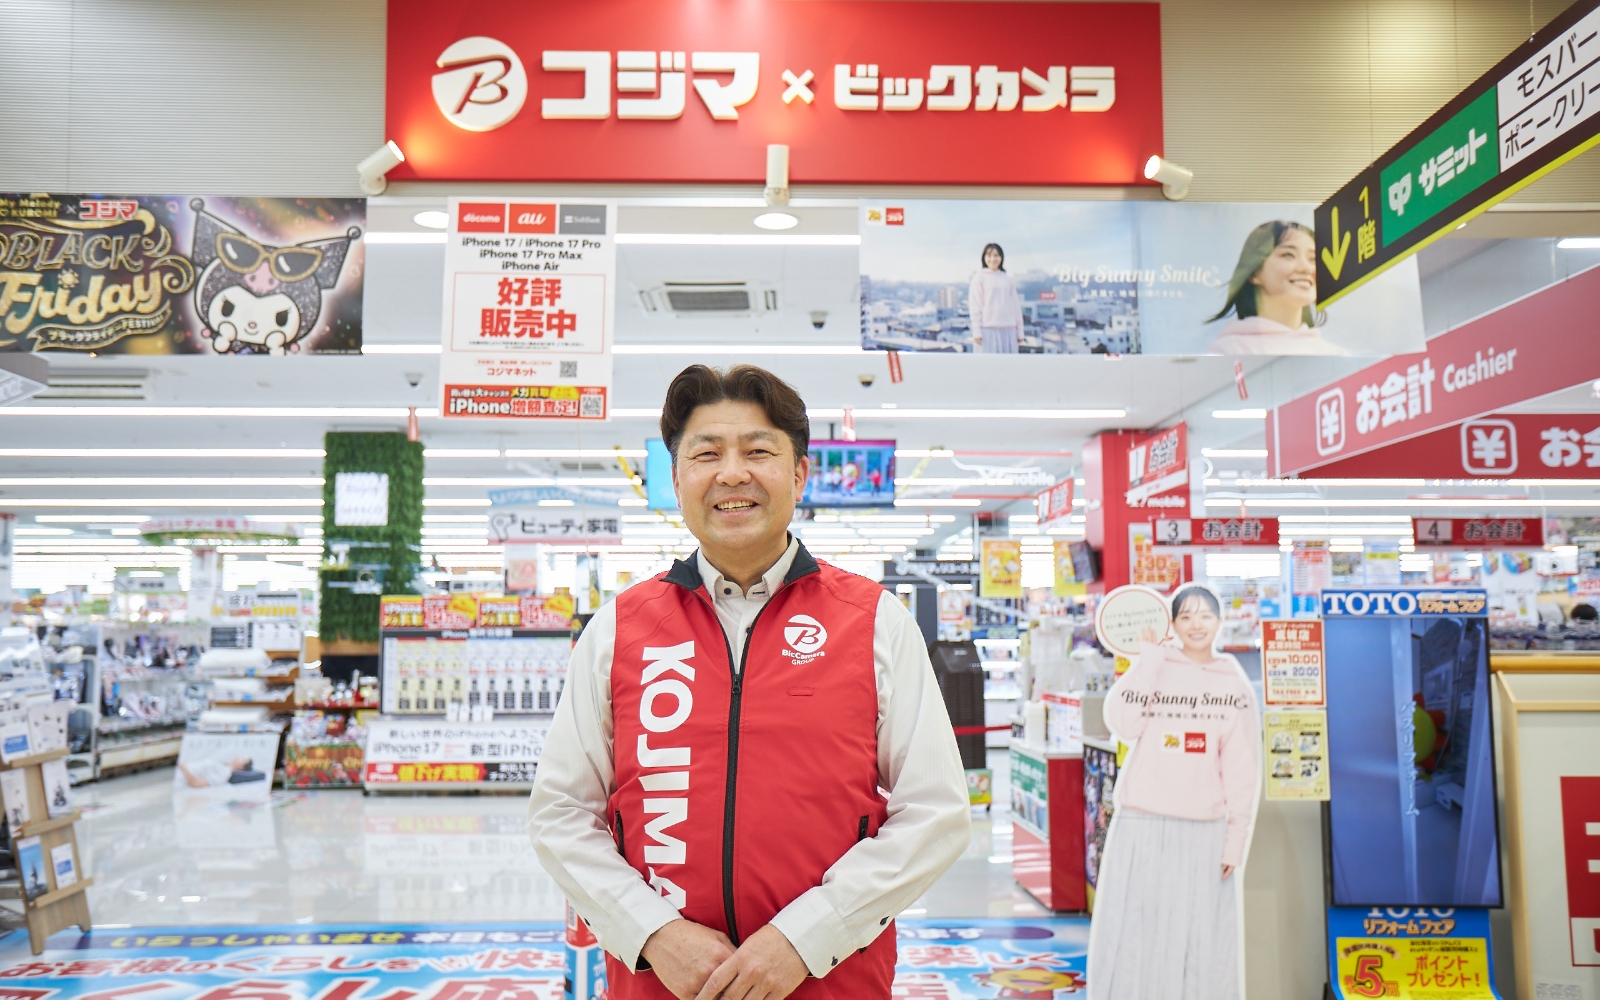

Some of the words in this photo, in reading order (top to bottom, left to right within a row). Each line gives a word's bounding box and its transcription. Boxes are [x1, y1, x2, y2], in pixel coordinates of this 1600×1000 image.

[541, 50, 760, 121] コジマ
[833, 63, 1116, 113] ビックカメラ
[1418, 128, 1488, 197] サミット
[79, 199, 139, 220] コジマ
[463, 212, 500, 223] docomo
[517, 212, 547, 225] au
[3, 231, 145, 273] BLACK
[462, 237, 501, 247] iPhone
[505, 238, 516, 247] 17
[525, 238, 564, 248] iPhone
[568, 239, 579, 248] 17
[582, 240, 601, 249] Pro
[479, 248, 518, 259] iPhone
[522, 250, 533, 259] 17
[536, 250, 555, 260] Pro
[558, 250, 582, 260] Max
[502, 260, 540, 271] iPhone
[544, 261, 560, 271] Air
[1054, 264, 1091, 288] Big
[1094, 264, 1155, 288] Sunny
[1159, 264, 1222, 288] Smile
[497, 276, 562, 307] 好評
[0, 269, 162, 334] Friday
[480, 307, 577, 339] 販売中
[487, 366, 537, 377] コジマネット
[1356, 357, 1436, 435] お会計
[1443, 346, 1518, 393] Cashier
[521, 518, 619, 534] ビューティ家電
[1167, 522, 1179, 541] 3
[1202, 518, 1264, 541] お会計
[1427, 521, 1440, 541] 4
[1464, 519, 1526, 541] お会計
[1322, 590, 1417, 616] TOTO
[781, 649, 825, 660] BicCamera
[791, 657, 815, 665] GROUP
[1288, 654, 1319, 665] 10:00
[1121, 689, 1149, 708] Big
[1151, 690, 1198, 709] Sunny
[1200, 692, 1248, 710] Smile
[1363, 918, 1456, 936] リフォームフェア
[110, 931, 405, 948] いらっしゃいませ
[1415, 953, 1469, 971] ポイント
[1406, 971, 1481, 988] プレゼント!
